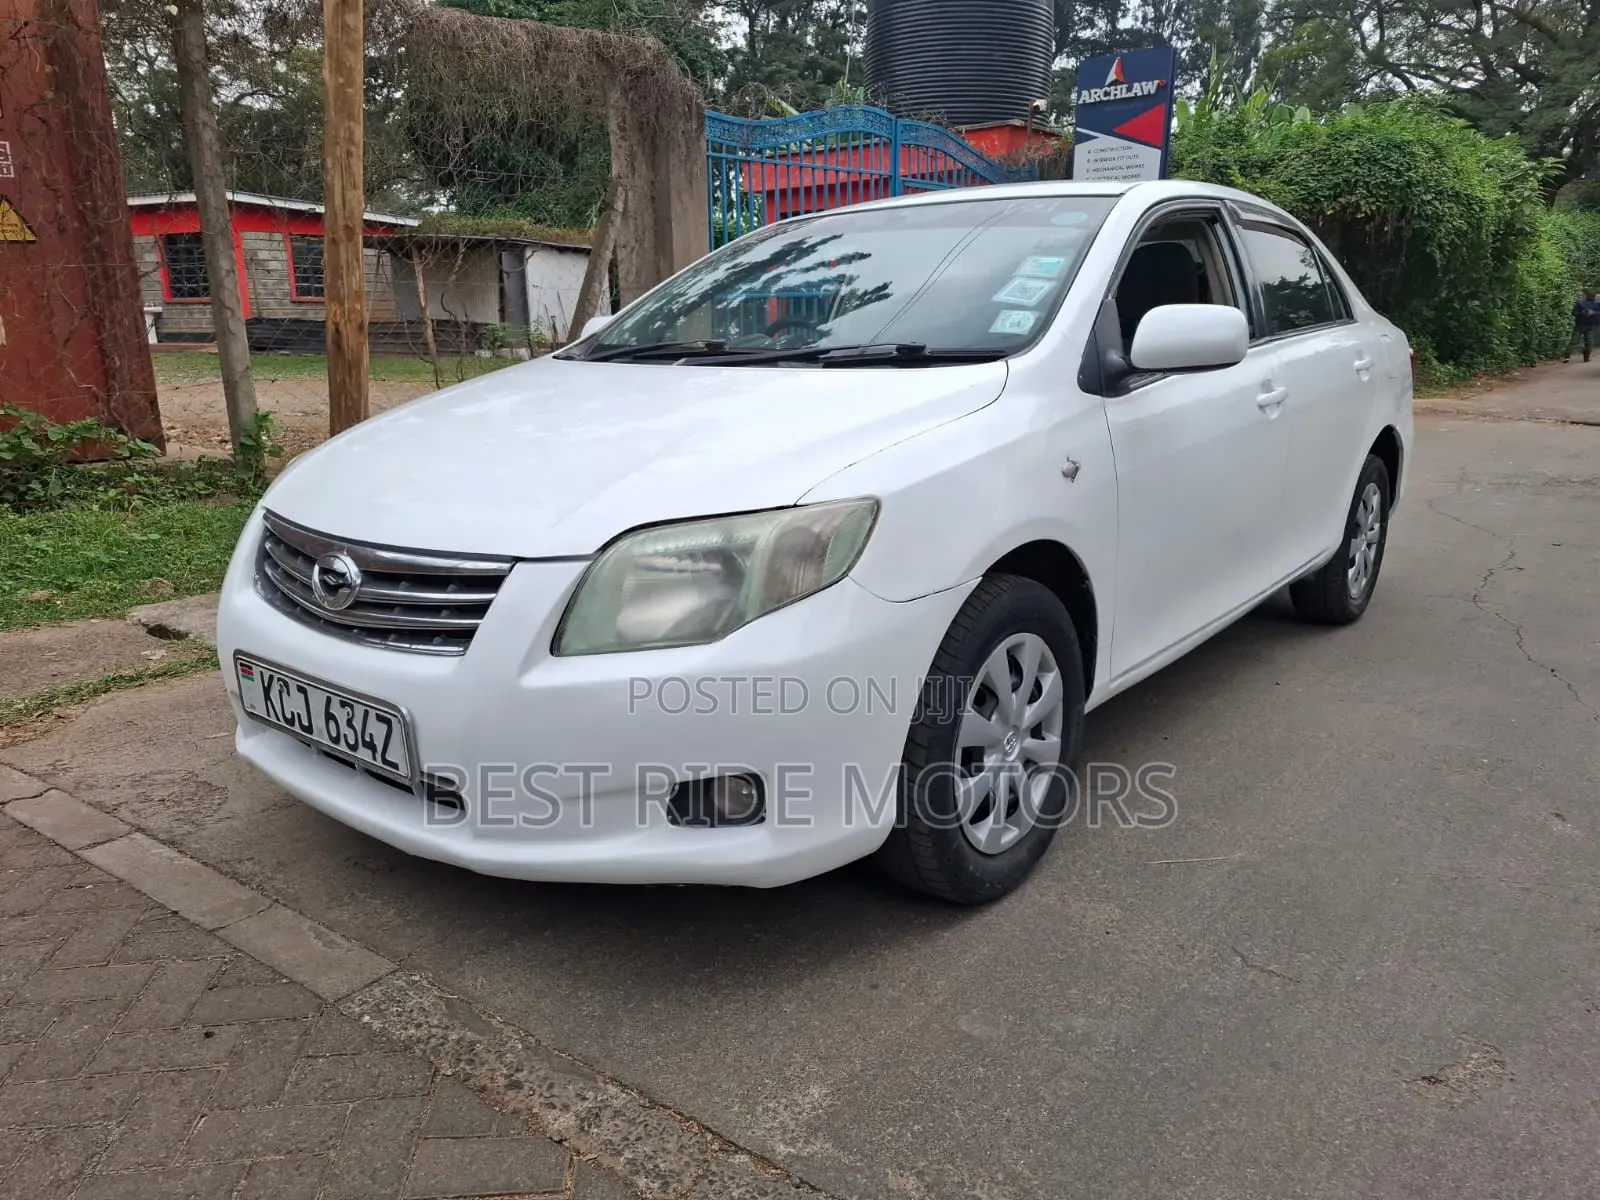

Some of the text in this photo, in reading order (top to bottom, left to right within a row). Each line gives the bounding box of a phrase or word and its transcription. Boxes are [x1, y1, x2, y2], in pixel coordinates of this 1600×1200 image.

[1077, 80, 1161, 104] ARCHLAW
[1093, 145, 1133, 154] CONSTRUCTION
[1092, 163, 1145, 173] MECHANICAL WORKS
[260, 670, 399, 771] KCJ 634Z
